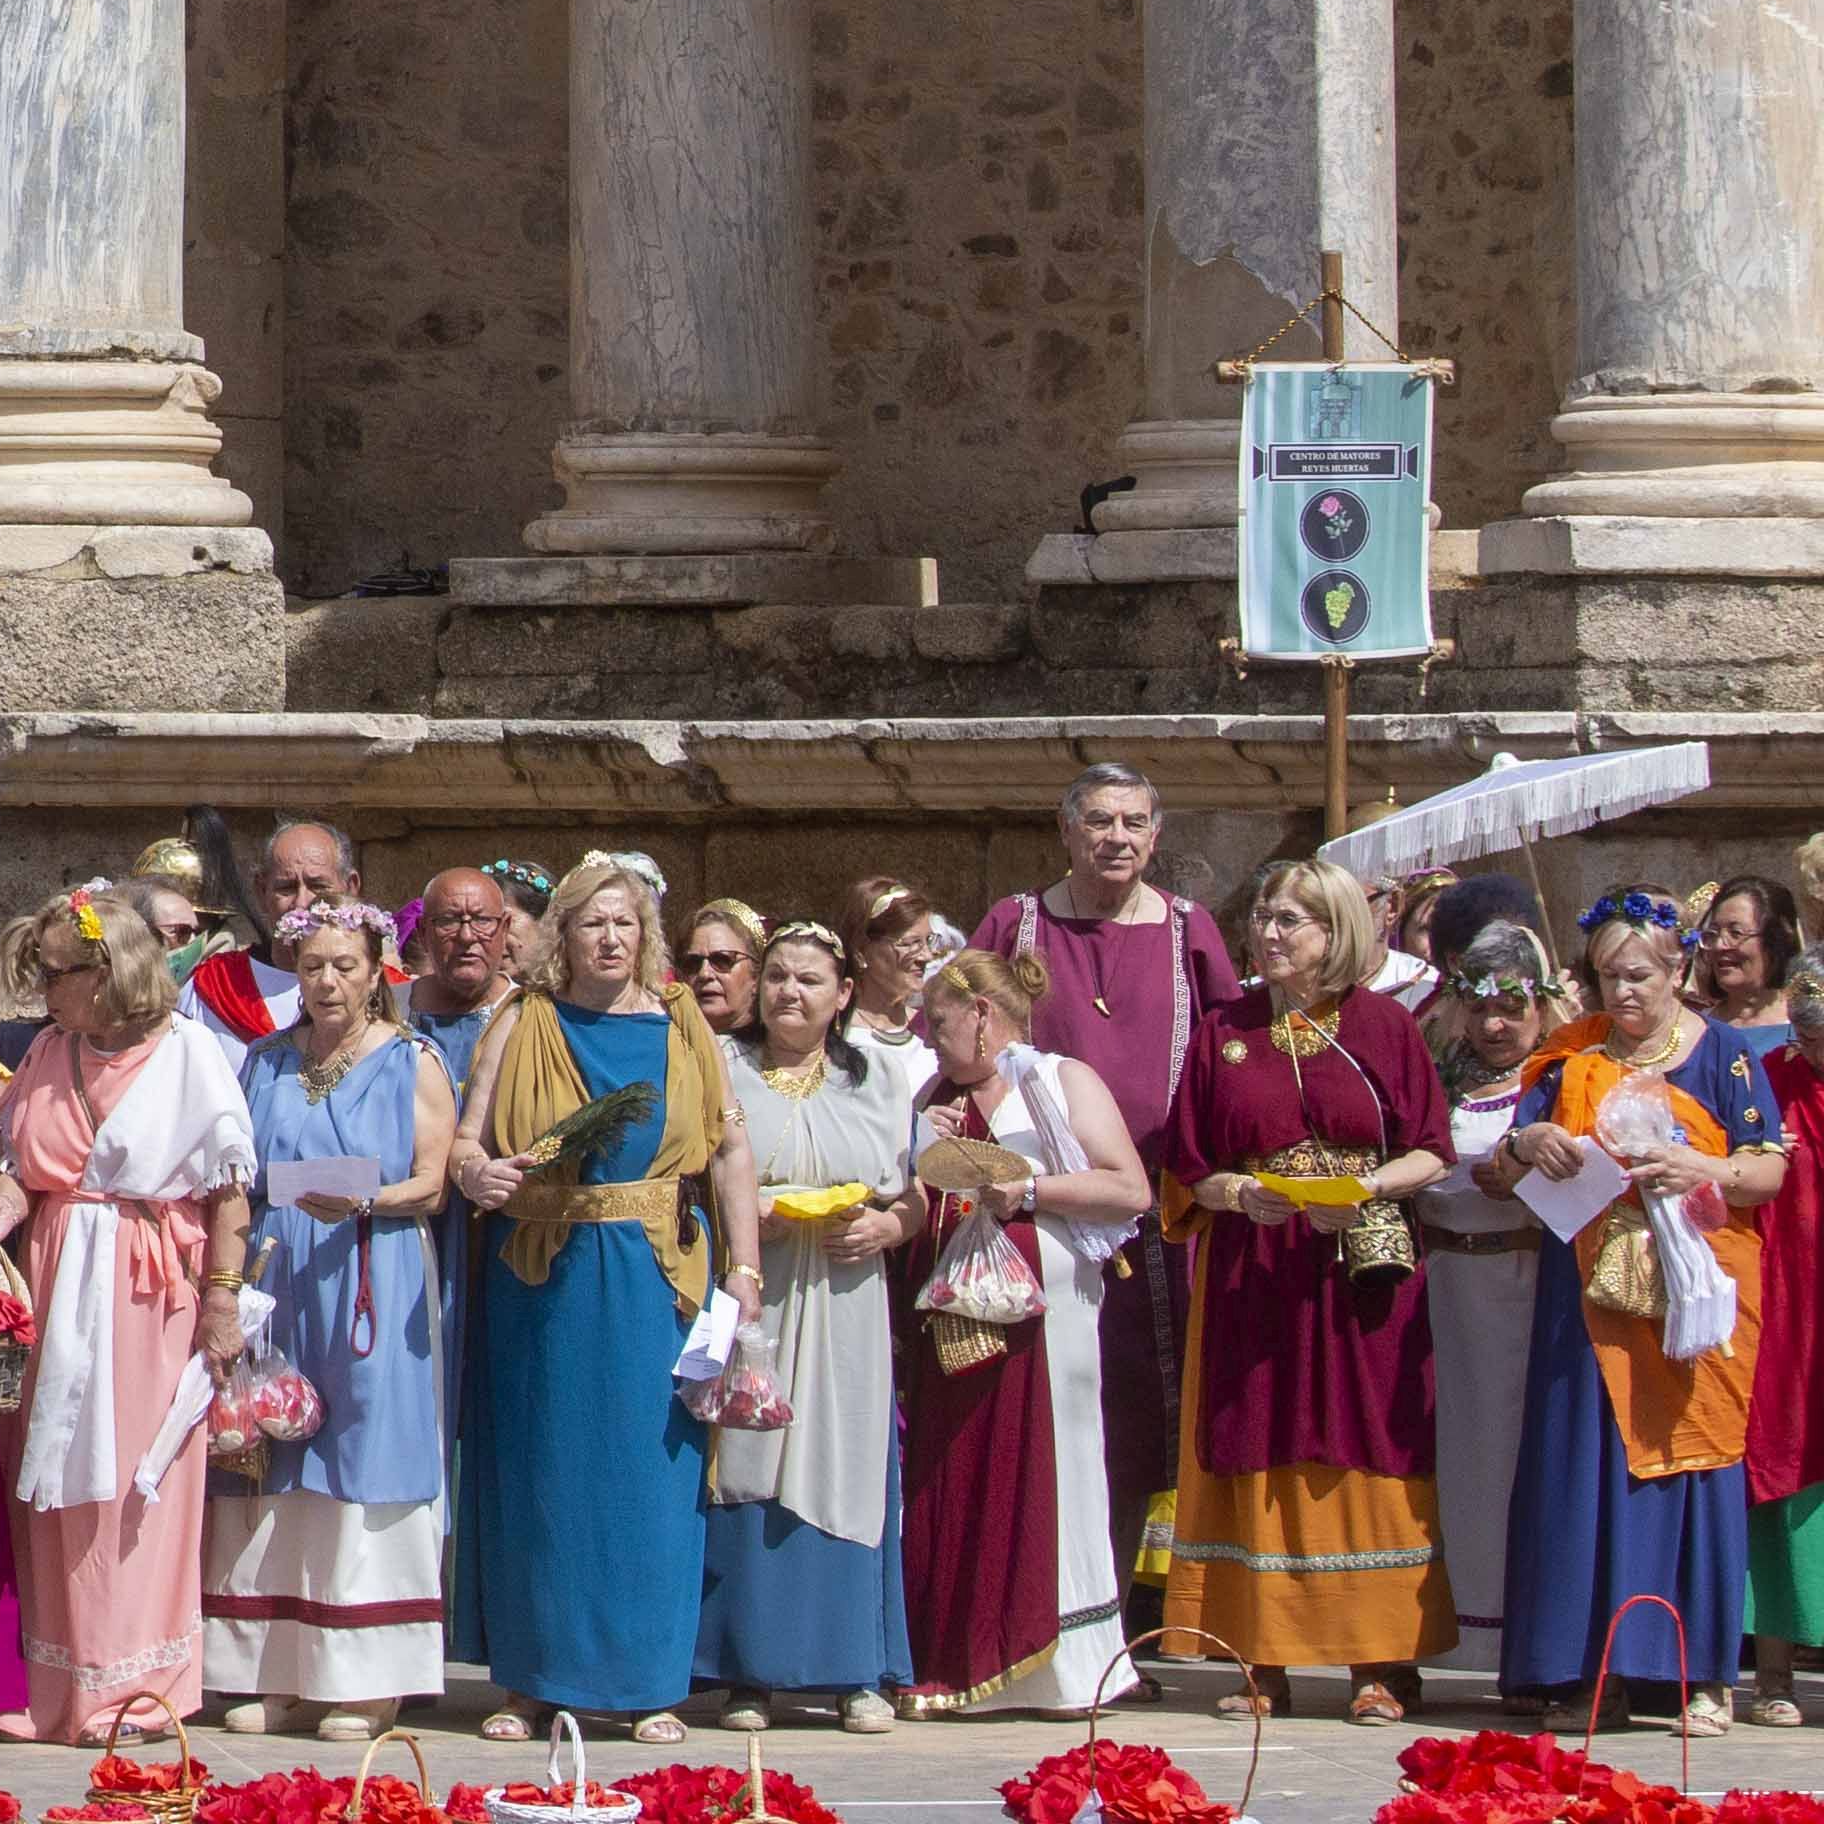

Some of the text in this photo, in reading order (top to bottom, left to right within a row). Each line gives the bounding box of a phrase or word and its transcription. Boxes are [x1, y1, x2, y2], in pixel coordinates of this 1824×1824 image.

[1289, 452, 1381, 461] CENTRO DE MAYORES
[1302, 464, 1369, 473] REYES HUERTAS
